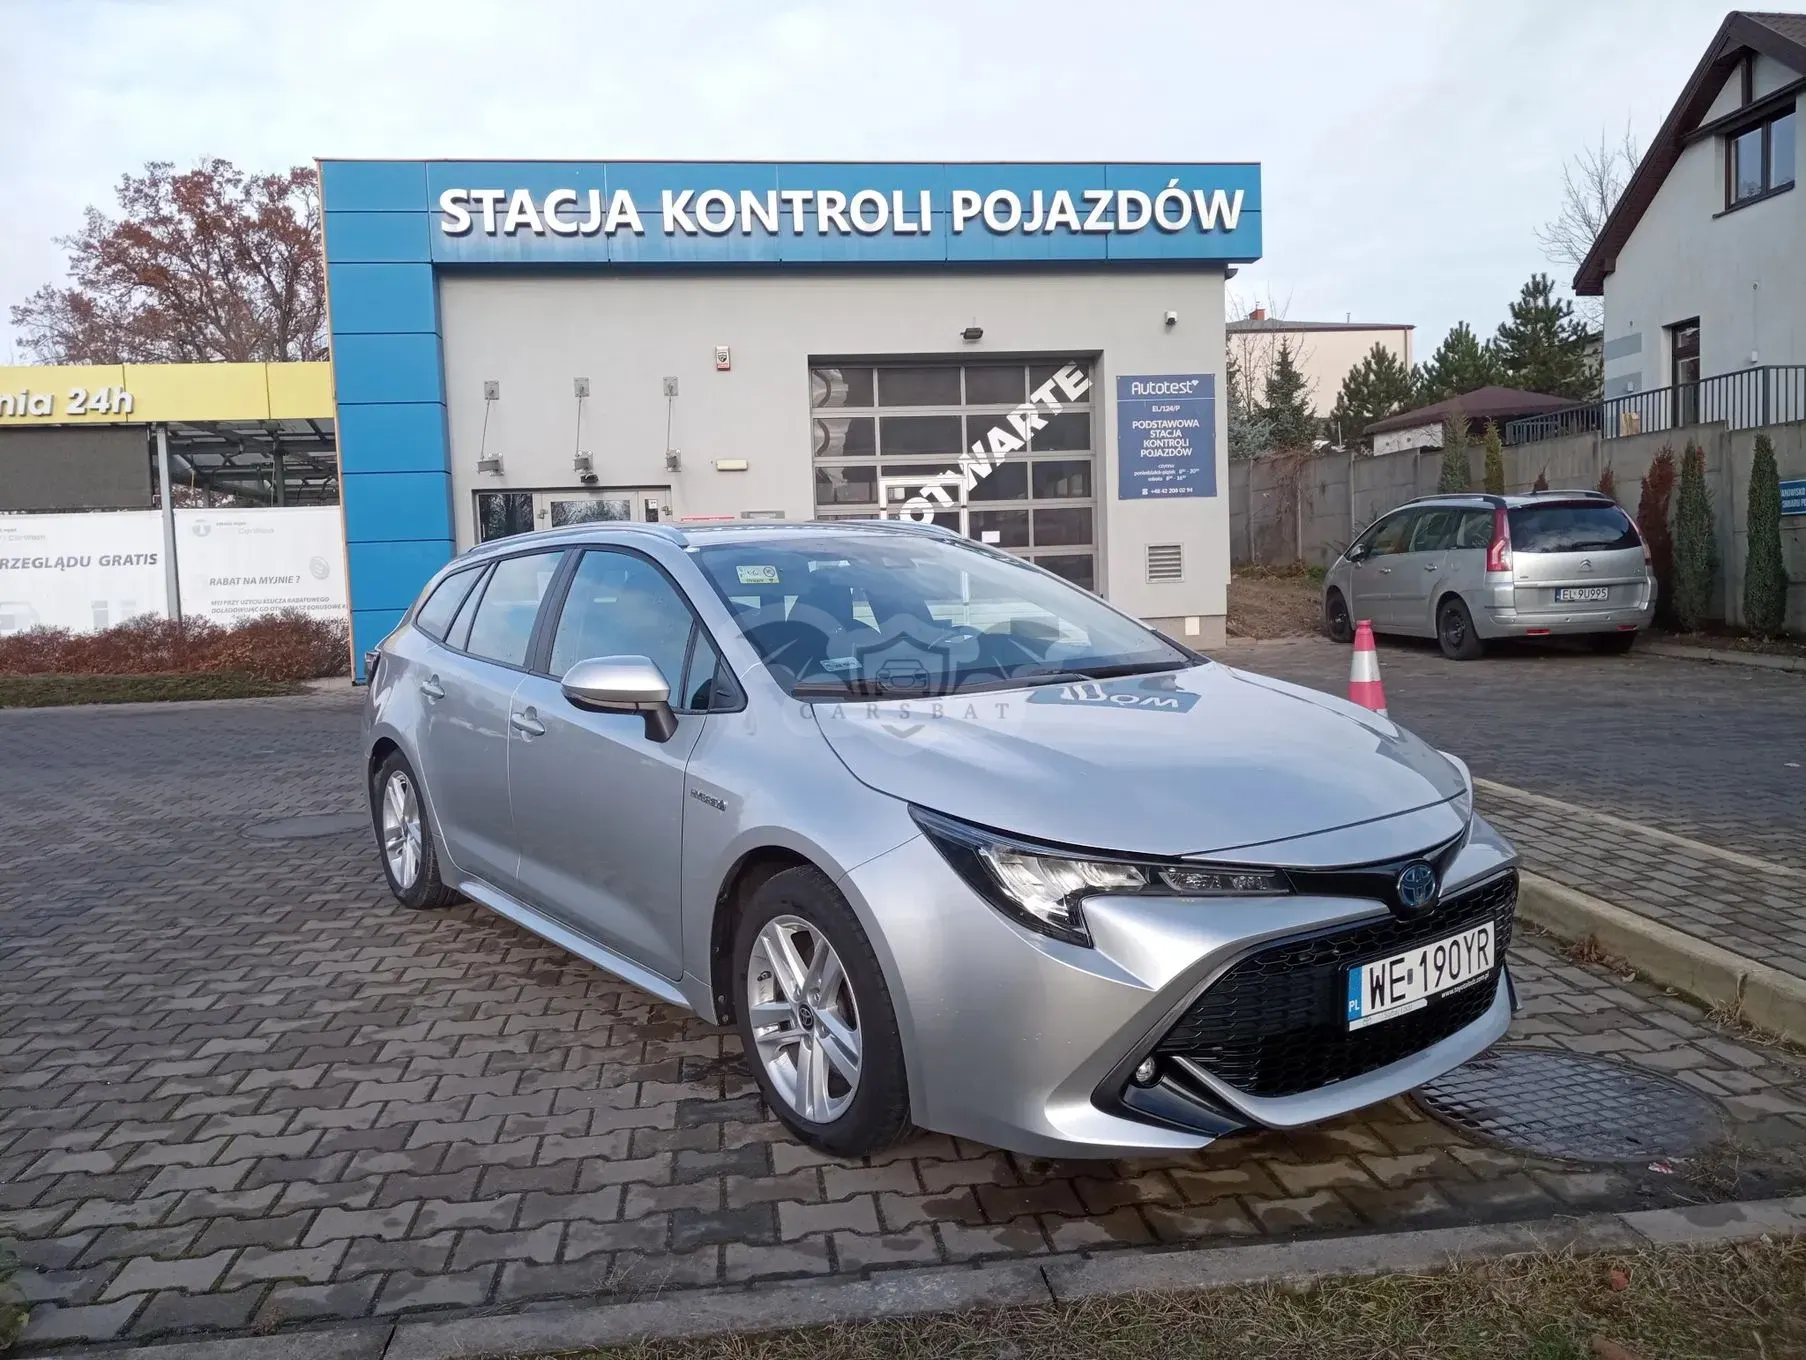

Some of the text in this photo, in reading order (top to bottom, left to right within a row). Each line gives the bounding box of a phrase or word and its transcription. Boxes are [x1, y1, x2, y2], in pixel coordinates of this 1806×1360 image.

[439, 178, 1244, 235] STACJA KONTROLI POJAZDÓW
[1131, 381, 1193, 395] Autotest
[0, 385, 134, 416] nia 24h
[1132, 419, 1200, 429] PODSTAWOWA
[1150, 429, 1182, 438] STACJA
[899, 361, 1093, 524] OTWARTE
[1143, 438, 1189, 448] KONTROLI
[1140, 446, 1193, 457] POJAZDÓW
[0, 553, 158, 571] RZEGLĄDU GRATIS
[209, 575, 301, 586] RABAT NA MYJNIE ?
[1562, 588, 1607, 599] EL 9U995
[1369, 928, 1489, 1009] WE 190YR
[1348, 1000, 1360, 1012] PL
